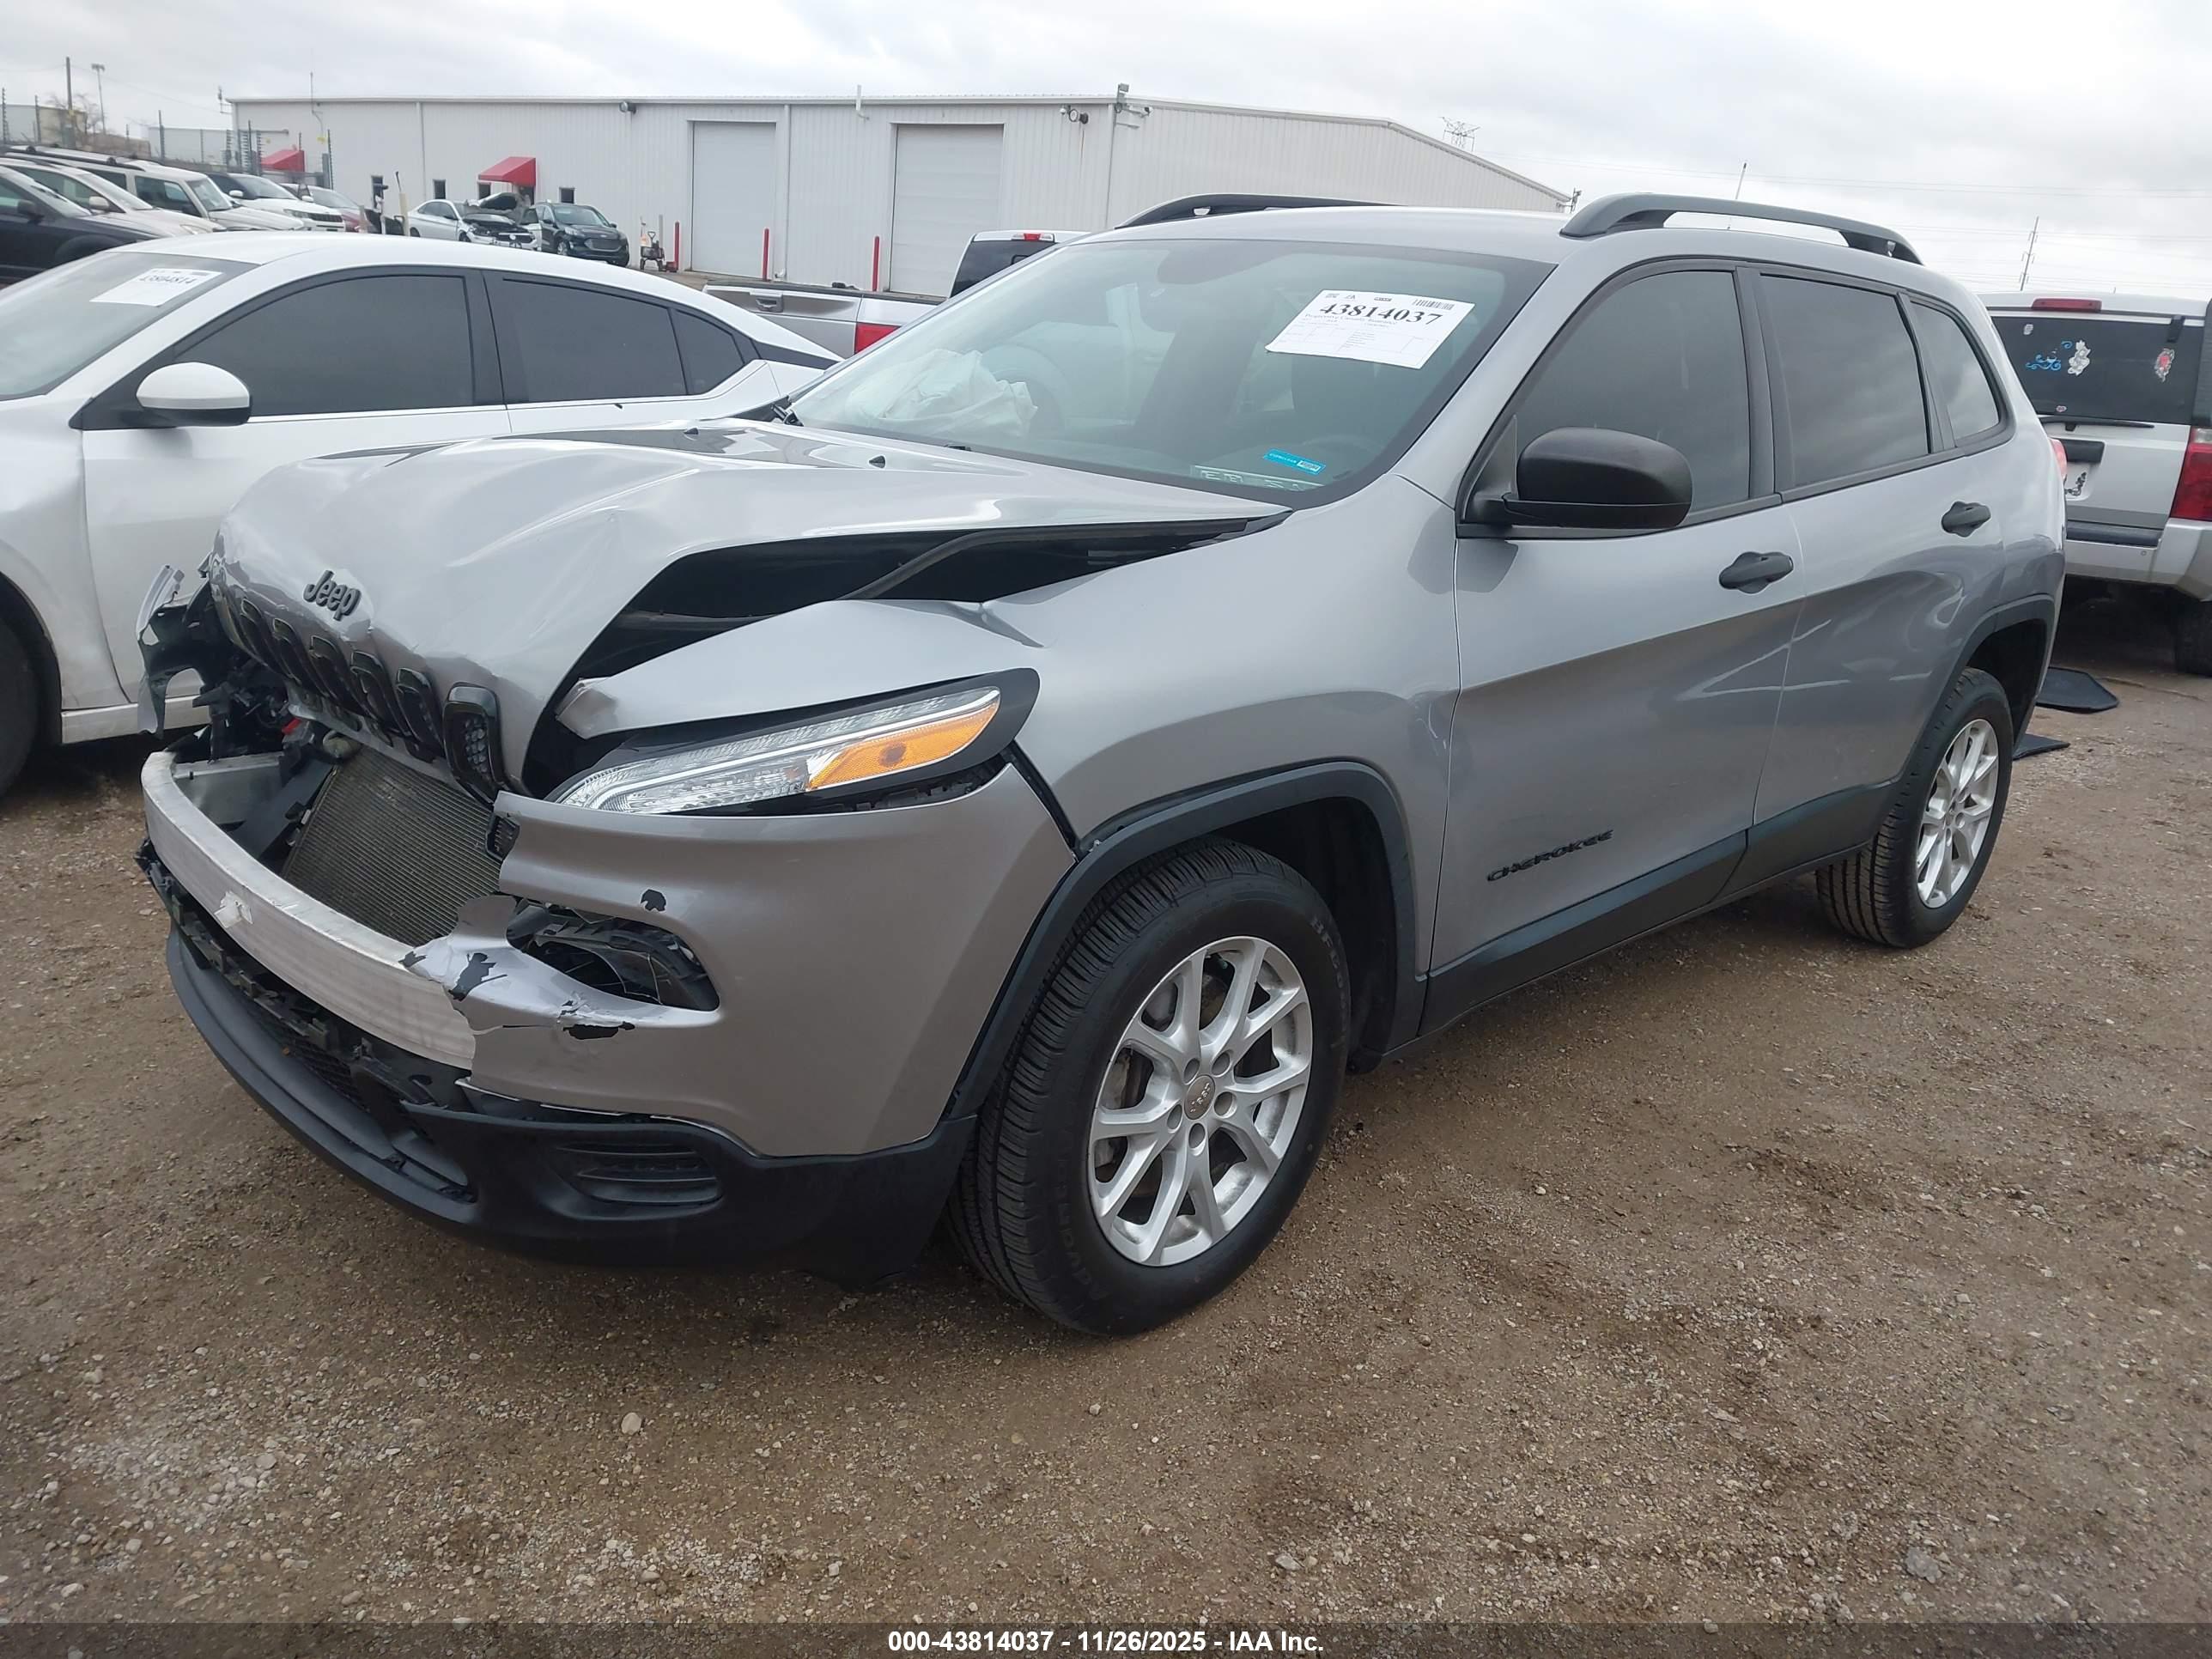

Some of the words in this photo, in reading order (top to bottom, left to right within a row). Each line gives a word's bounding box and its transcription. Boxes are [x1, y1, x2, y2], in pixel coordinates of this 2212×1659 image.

[1320, 303, 1443, 325] 43814037
[303, 569, 362, 622] Jeep
[1487, 830, 1613, 881] CHEROKEE
